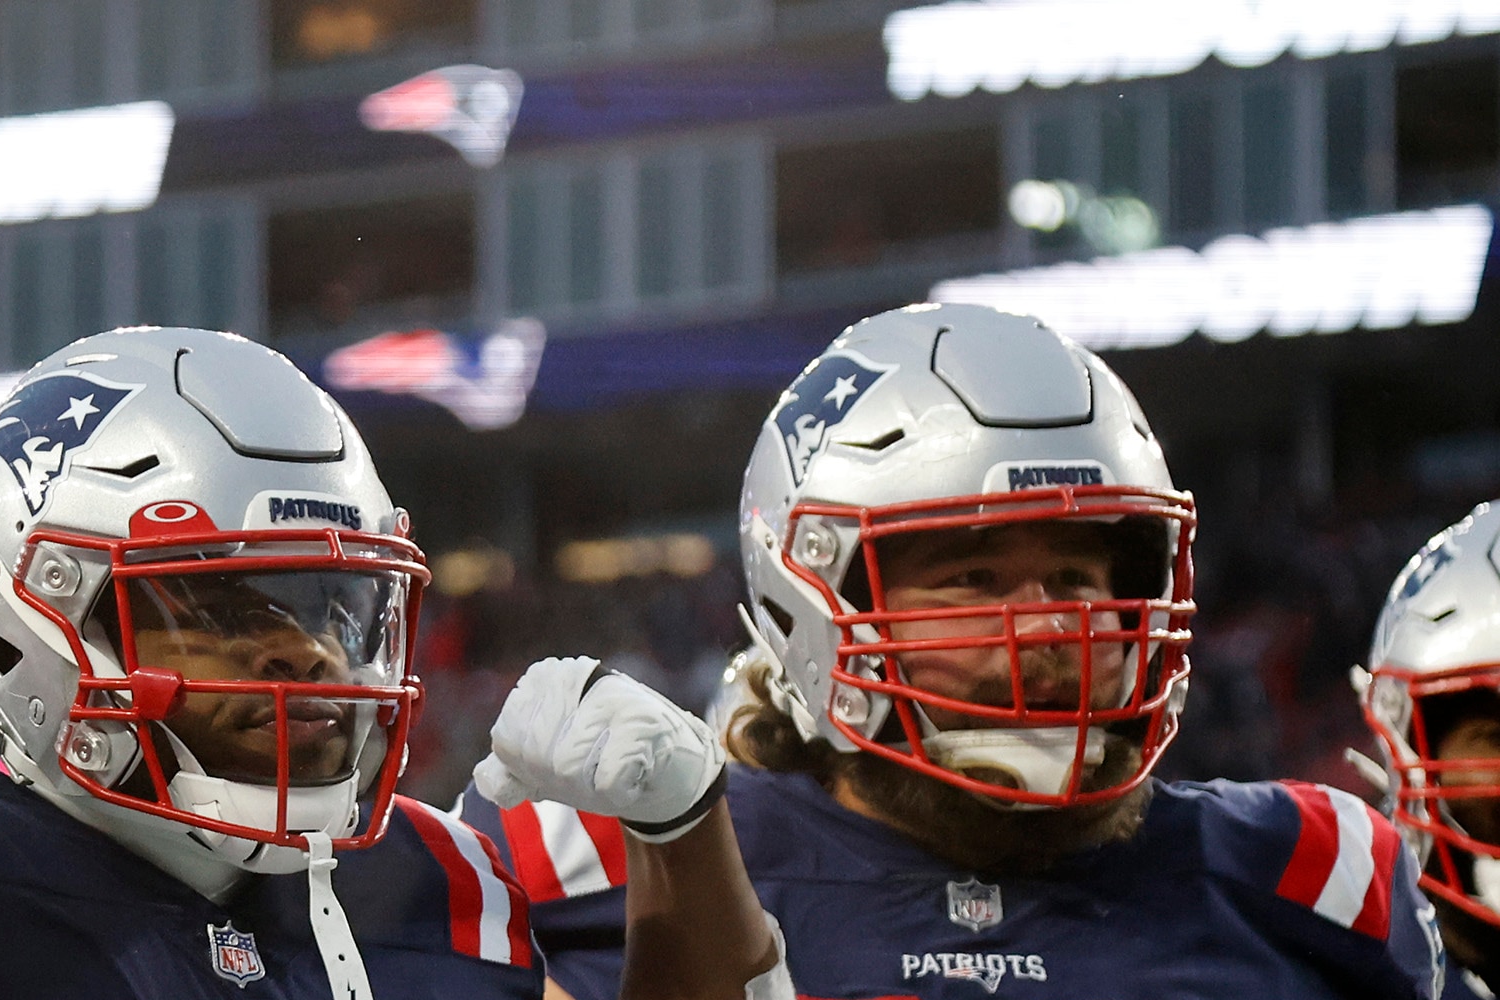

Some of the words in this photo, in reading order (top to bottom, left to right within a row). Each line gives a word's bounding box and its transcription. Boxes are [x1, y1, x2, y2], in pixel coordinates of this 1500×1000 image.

[268, 497, 362, 531] PATRIOTS
[221, 947, 258, 974] NFL
[901, 952, 1048, 982] PATRIOTS
